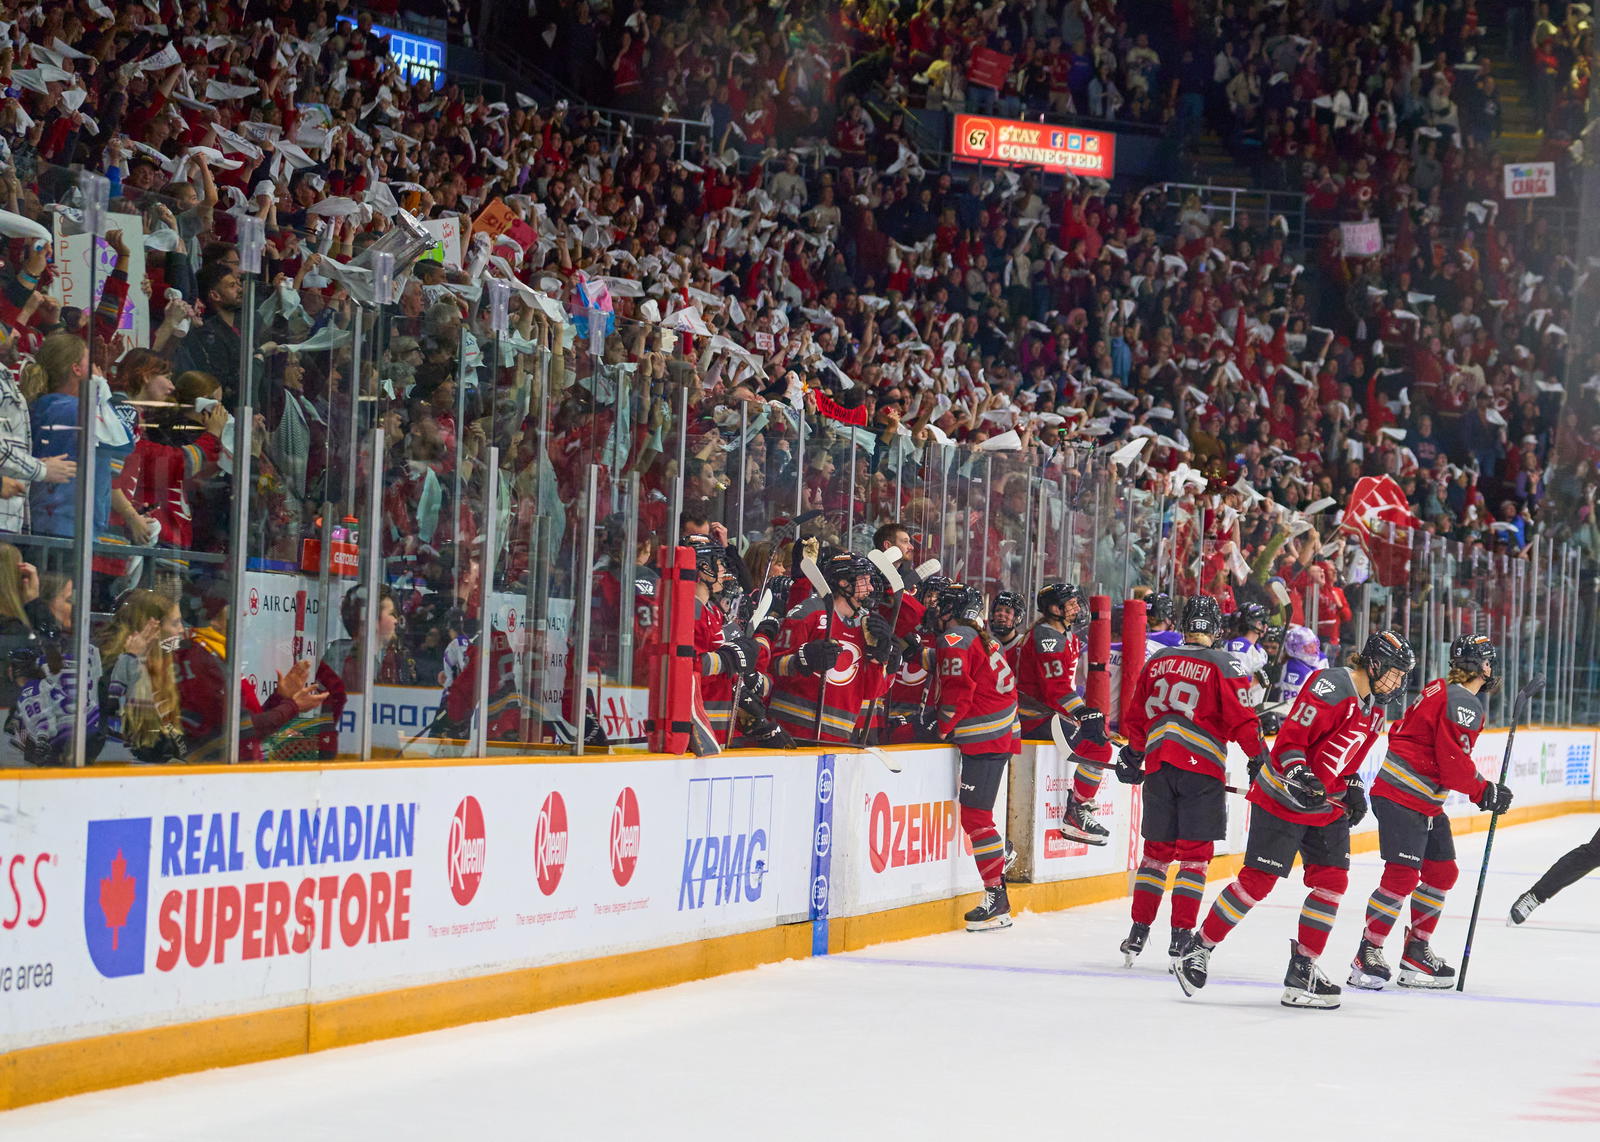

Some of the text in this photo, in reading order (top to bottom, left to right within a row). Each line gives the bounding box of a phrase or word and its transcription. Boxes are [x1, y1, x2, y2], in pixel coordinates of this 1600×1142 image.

[969, 130, 986, 147] 67
[998, 125, 1040, 145] STAY
[998, 144, 1103, 169] CONNECTED!
[263, 595, 319, 614] AIR CAAD
[1195, 621, 1207, 630] 88
[306, 640, 316, 657] AI
[1456, 647, 1463, 656] 3
[941, 658, 963, 676] 22
[1043, 660, 1064, 678] 13
[1290, 702, 1318, 727] 19
[1460, 733, 1471, 755] 3
[161, 802, 416, 878] REAL CANADIAN
[449, 796, 485, 890] Rheem
[536, 792, 568, 880] Rheem
[611, 788, 640, 873] Rheem
[869, 791, 975, 873] OZEMPI
[677, 829, 767, 911] KPMG
[0, 852, 51, 930] SS
[156, 869, 413, 973] SUPERSTORE
[16, 962, 53, 991] area
